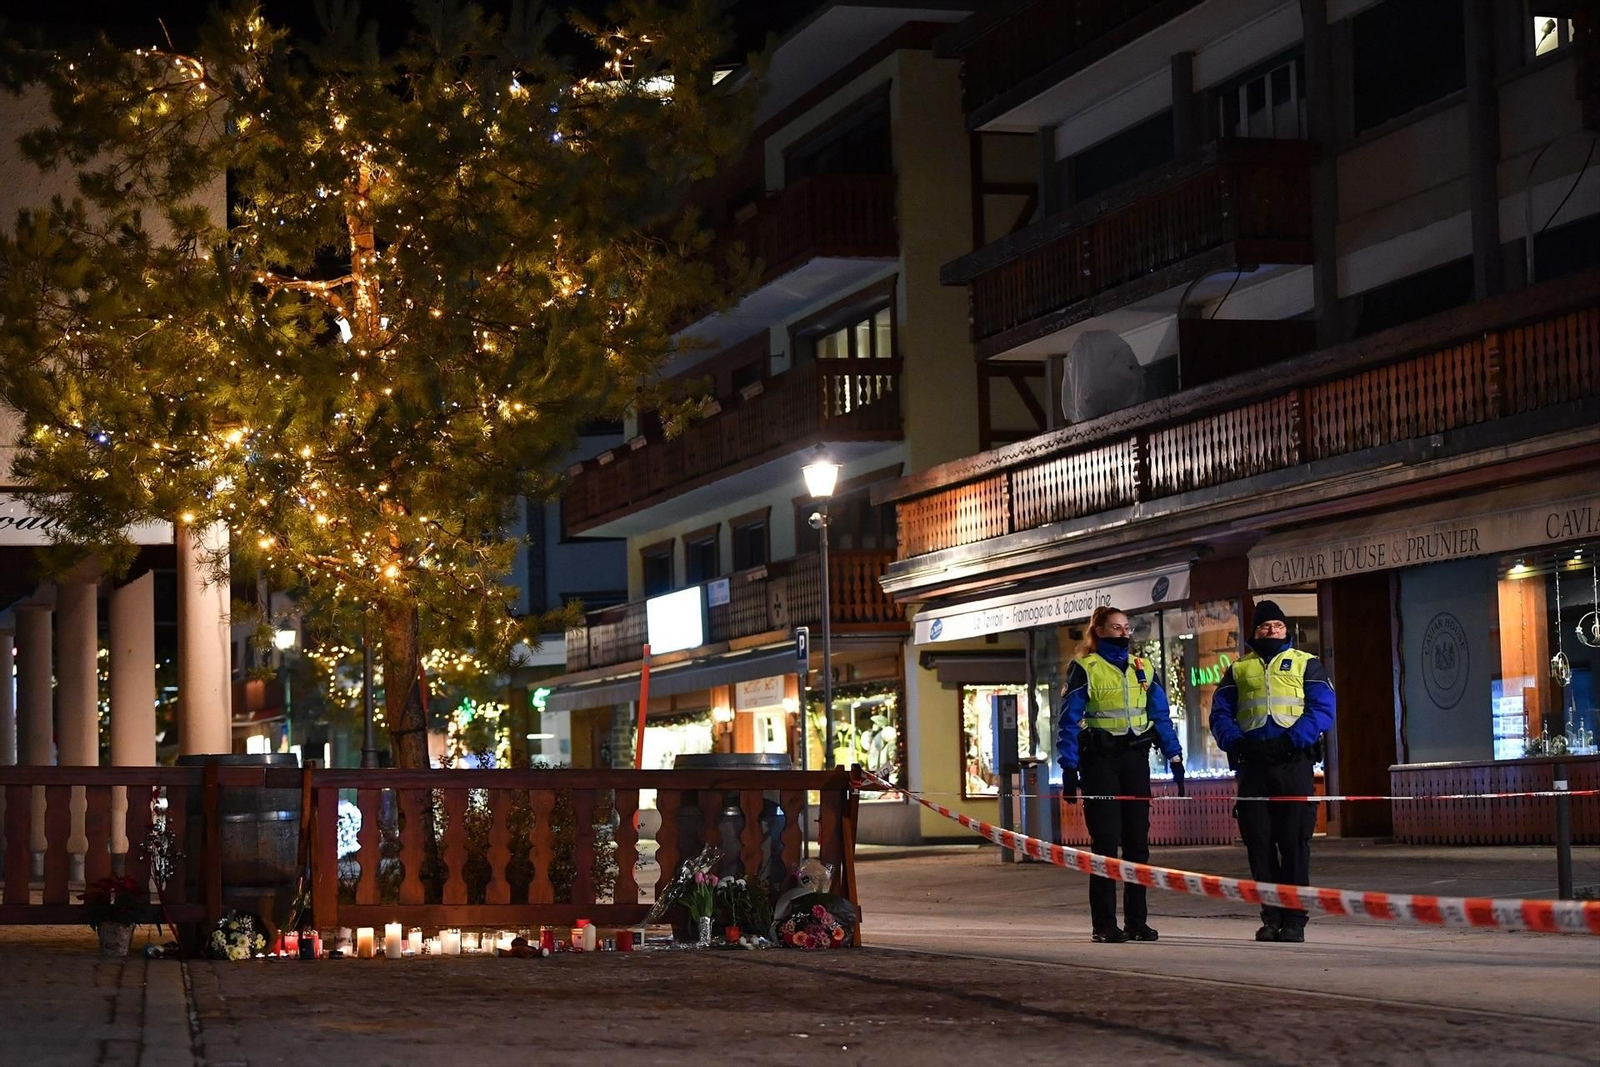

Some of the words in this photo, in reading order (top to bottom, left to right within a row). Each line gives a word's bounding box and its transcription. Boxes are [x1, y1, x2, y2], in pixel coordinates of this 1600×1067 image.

[1271, 554, 1326, 582] CAVIAR
[1333, 543, 1386, 571] HOUSE
[1391, 540, 1402, 564] &
[1407, 528, 1480, 561] PRUNIER
[1055, 598, 1062, 615] &
[1063, 592, 1093, 618] épicerie
[1095, 590, 1111, 607] fine
[799, 635, 805, 656] P
